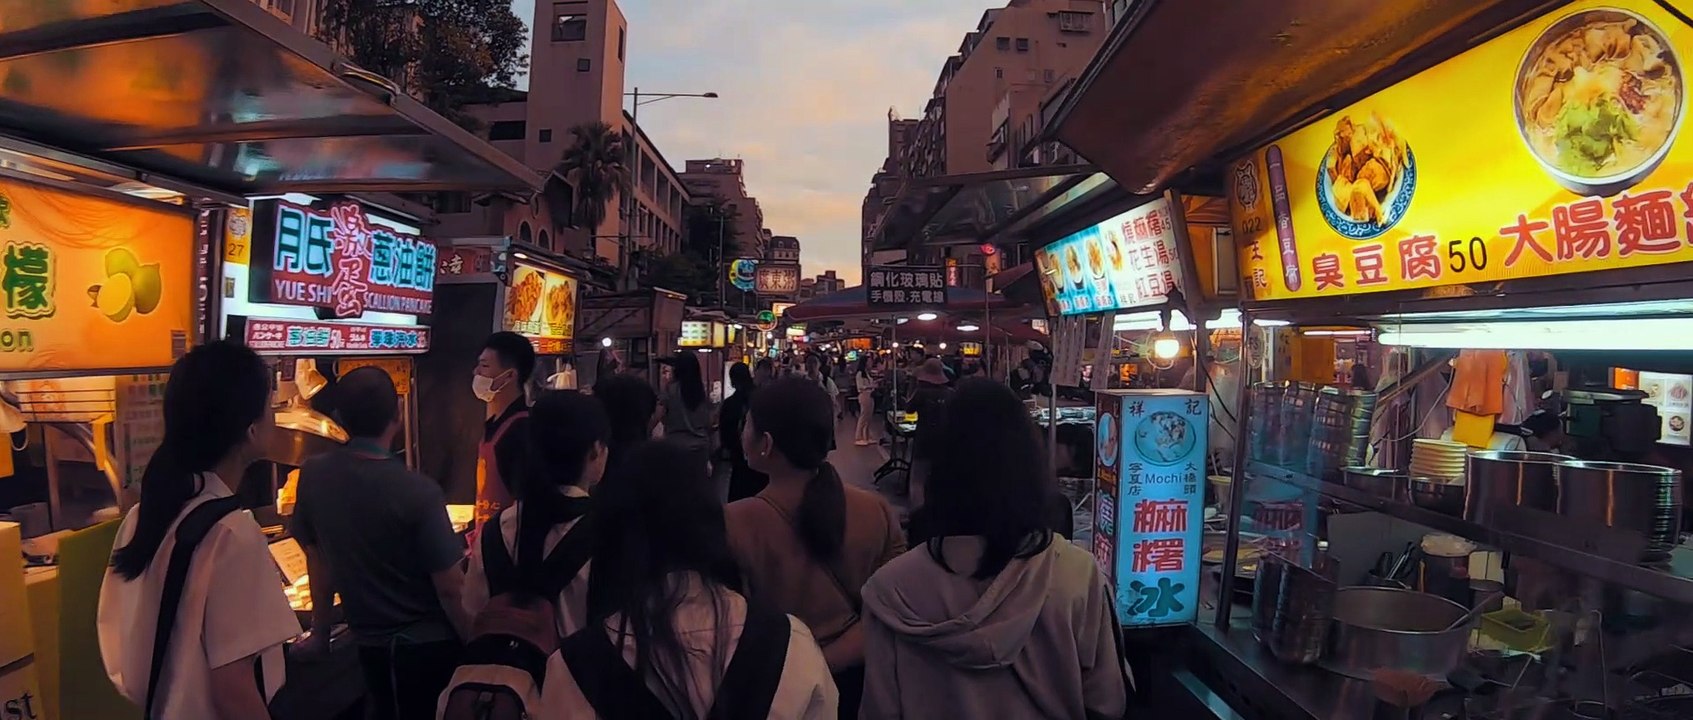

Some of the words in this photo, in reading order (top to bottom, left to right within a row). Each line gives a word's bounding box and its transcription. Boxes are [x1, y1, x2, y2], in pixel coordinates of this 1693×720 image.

[1241, 216, 1261, 234] 022
[1499, 181, 1693, 268] 大腸麵
[228, 243, 244, 256] 27
[273, 204, 335, 278] 月氏
[367, 229, 437, 292] 蔥油餅
[1312, 234, 1442, 291] 臭豆腐
[1448, 236, 1488, 273] 50
[870, 271, 944, 288] 鋼化玻璃貼
[274, 280, 306, 301] YUE
[307, 283, 334, 304] SHI
[363, 291, 401, 311] SCALLION
[1145, 472, 1183, 485] Mochi
